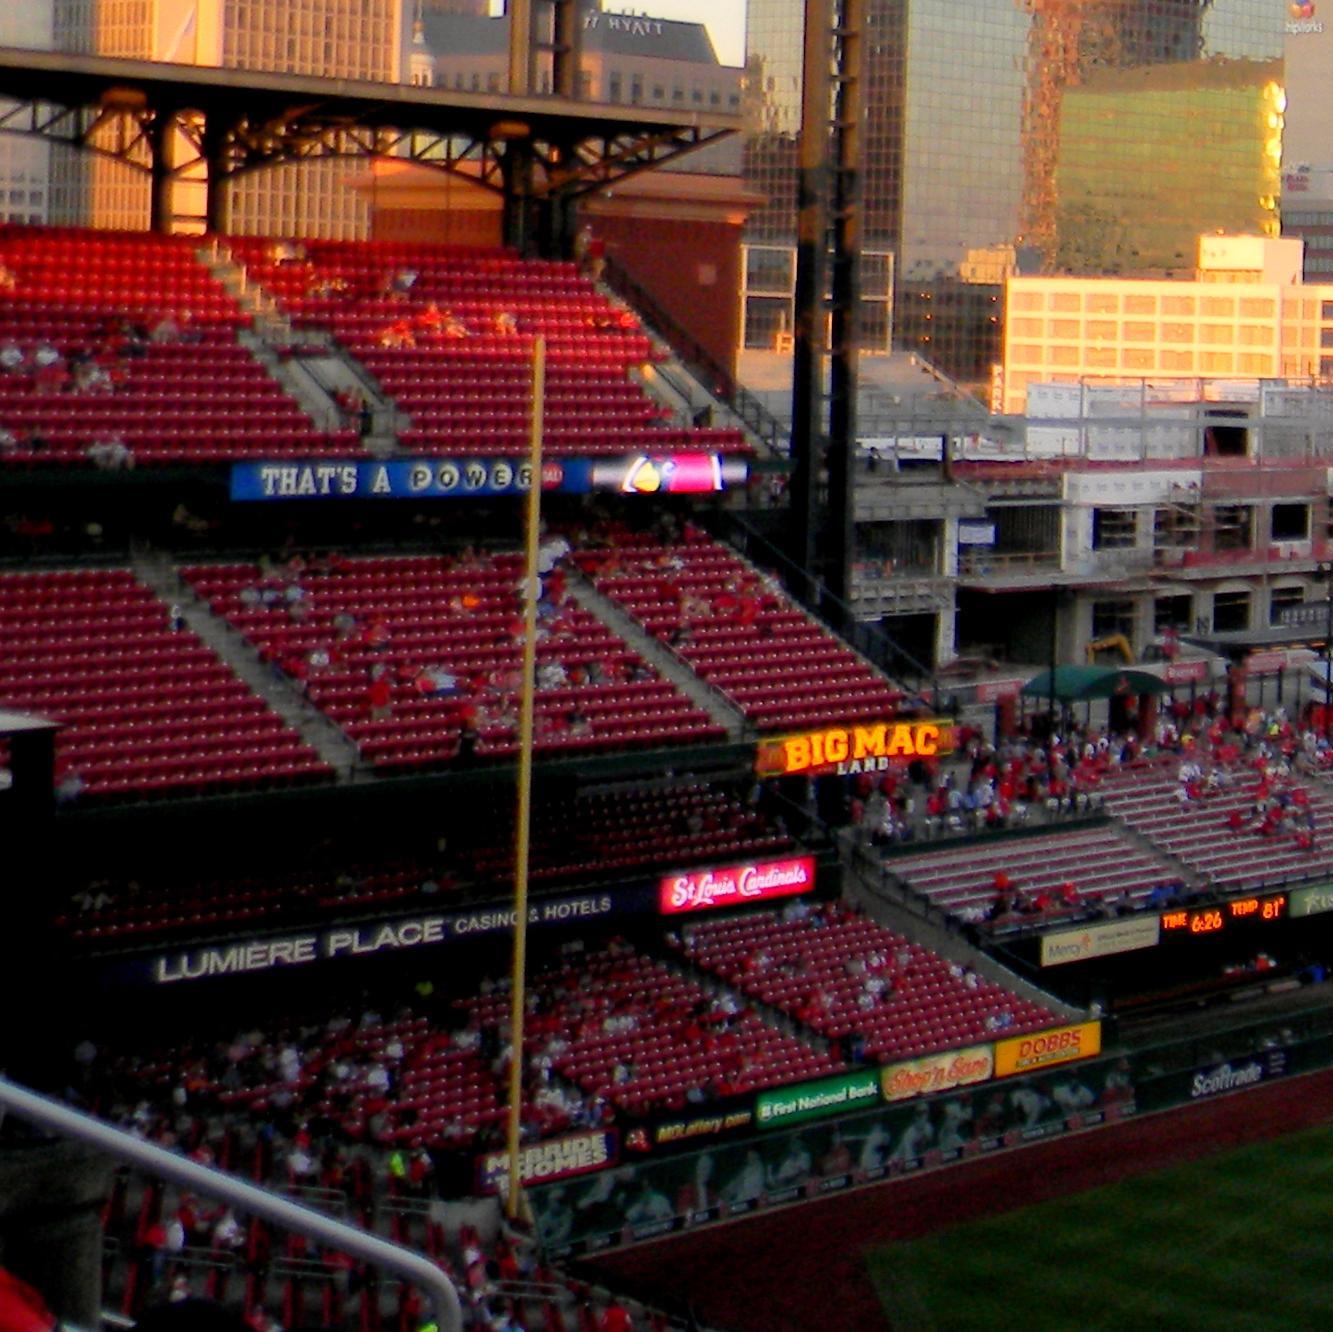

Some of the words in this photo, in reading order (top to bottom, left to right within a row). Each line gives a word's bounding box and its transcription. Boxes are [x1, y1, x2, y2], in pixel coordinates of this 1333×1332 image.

[609, 18, 662, 35] HYATT
[261, 466, 358, 496] THAT'S
[372, 466, 392, 494] A
[785, 729, 849, 772] BIG
[853, 724, 940, 759] MAC
[738, 864, 808, 897] Cardinals
[328, 918, 445, 957] PLACE
[545, 896, 612, 921] HOTELS
[1162, 912, 1188, 930] TIME
[1191, 911, 1223, 933] 6:26
[1231, 900, 1259, 916] TEMP
[1018, 1028, 1082, 1058] DOBBS
[1191, 1063, 1262, 1098] Scottrade
